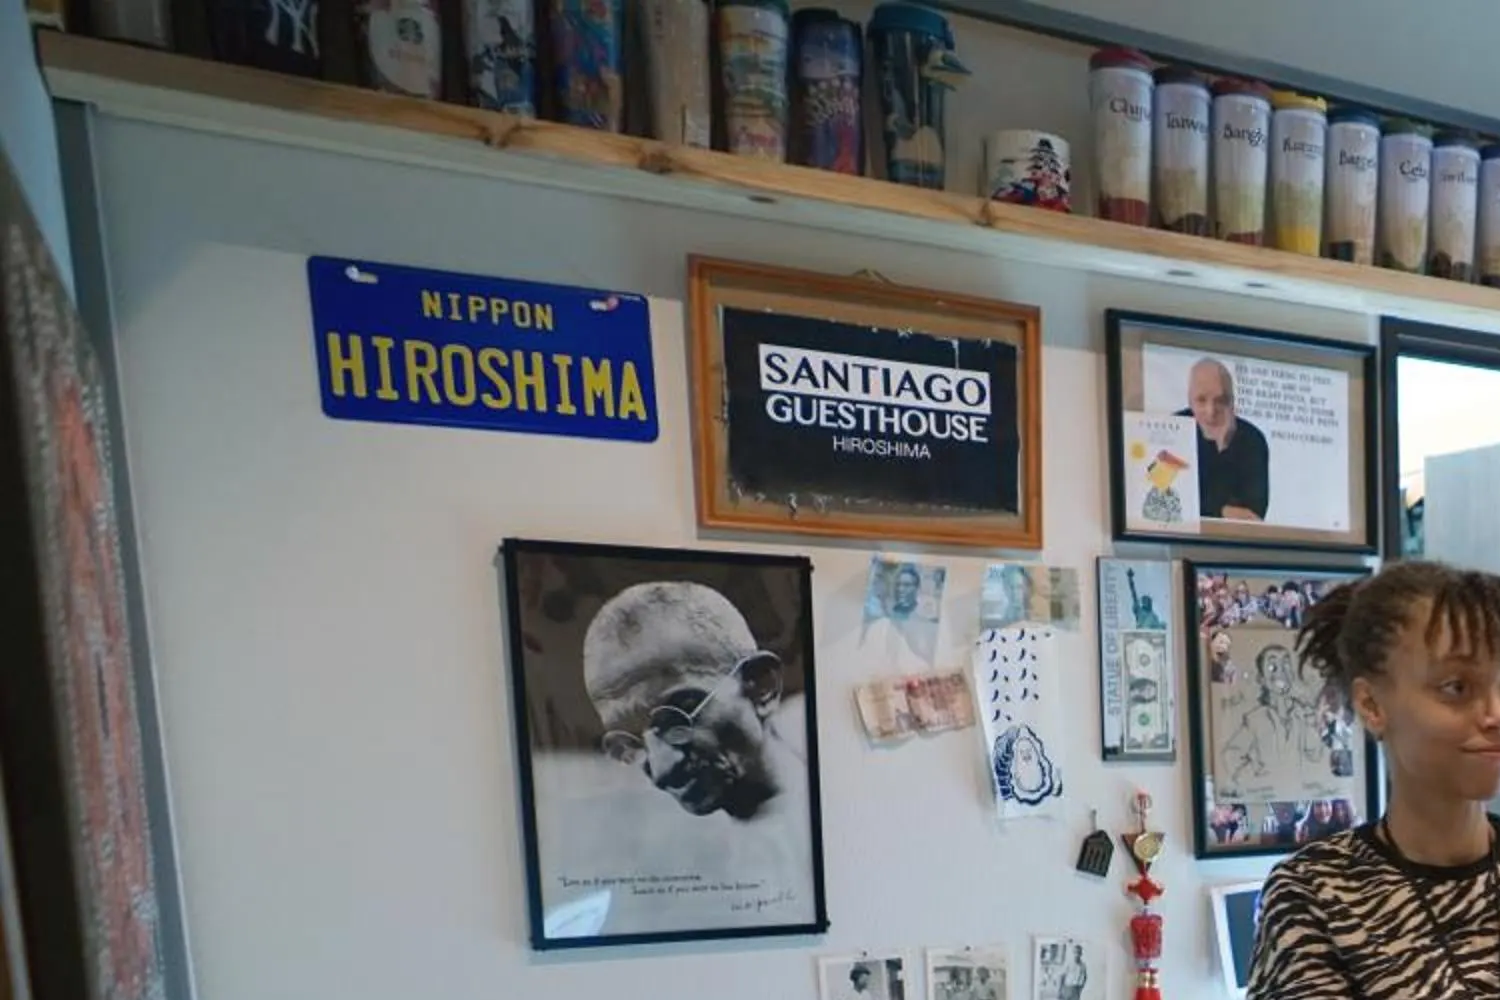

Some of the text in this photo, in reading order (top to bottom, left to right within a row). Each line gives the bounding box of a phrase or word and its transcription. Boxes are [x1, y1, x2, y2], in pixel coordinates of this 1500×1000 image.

[420, 290, 554, 331] NIPPON
[326, 331, 648, 421] HIROSHIMA
[764, 352, 987, 407] SANTIAGO
[765, 394, 989, 443] GUESTHOUSE
[832, 436, 931, 459] HIROSHIMA
[1107, 631, 1120, 652] OF
[1106, 659, 1120, 716] STATUE
